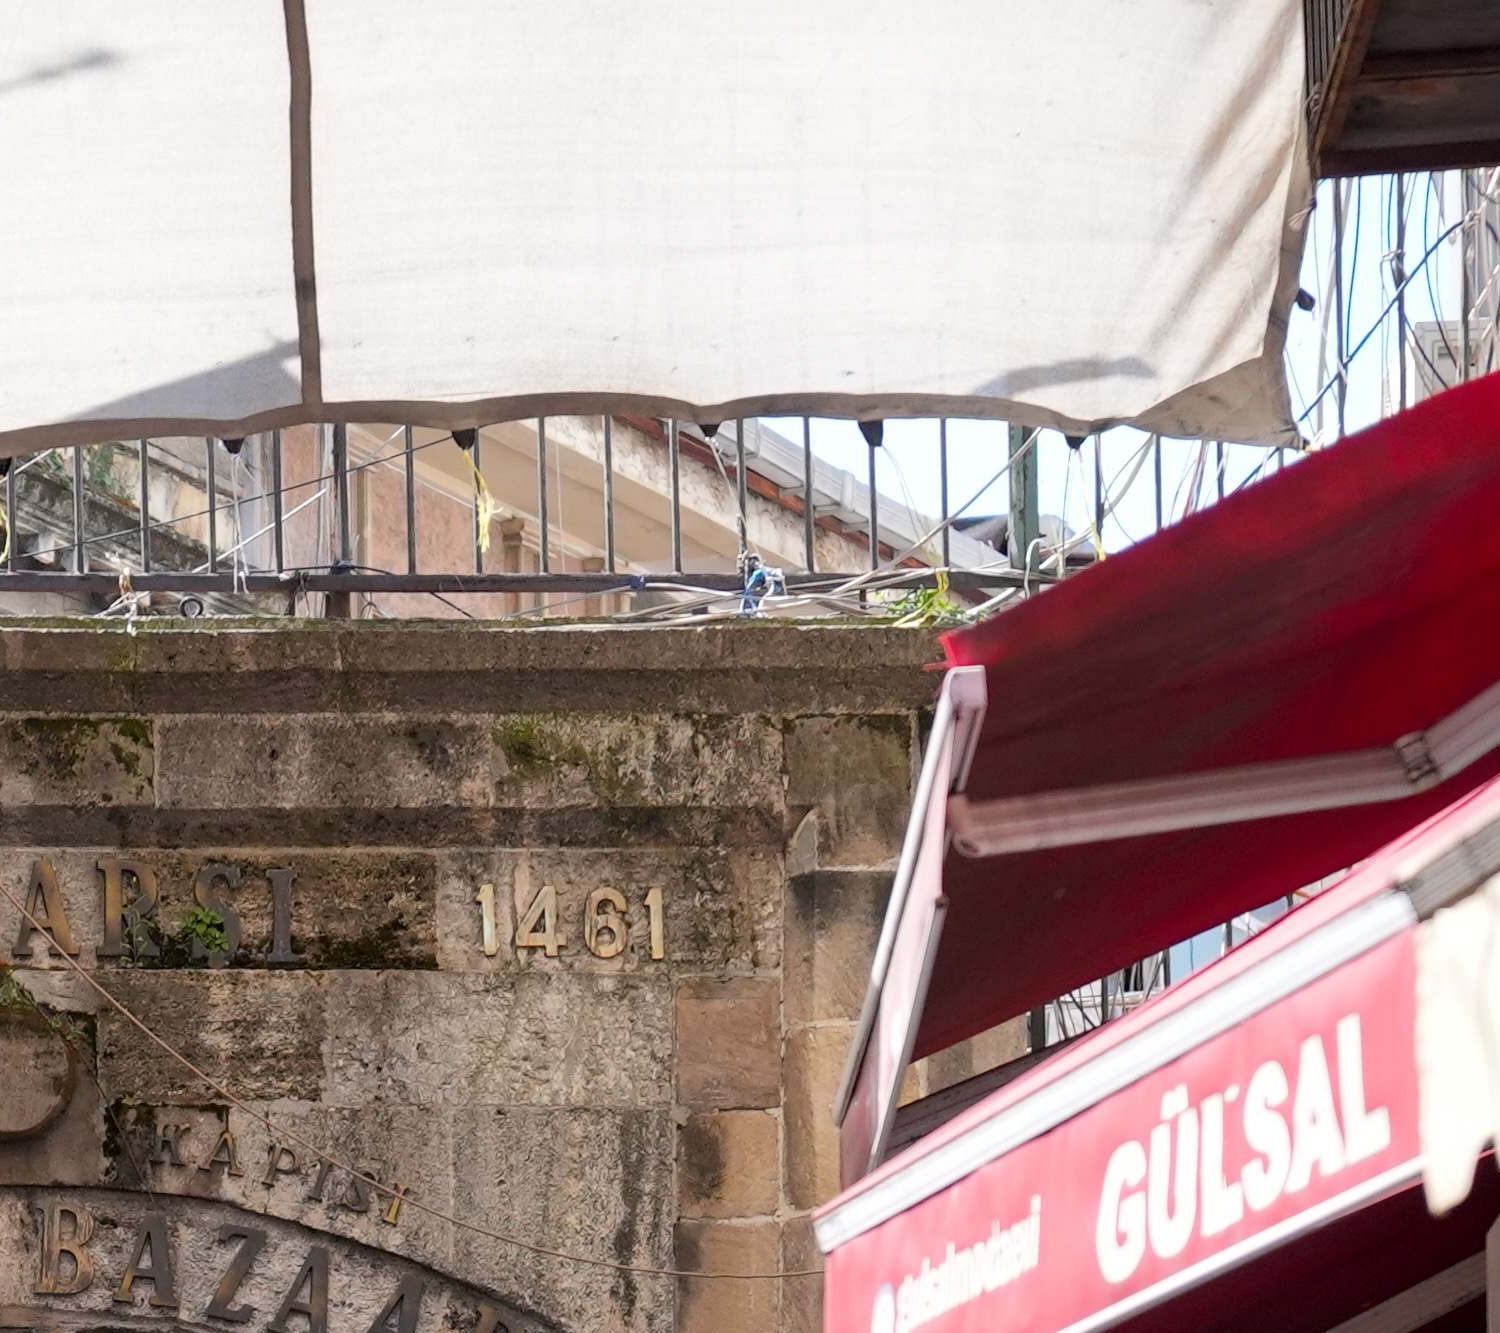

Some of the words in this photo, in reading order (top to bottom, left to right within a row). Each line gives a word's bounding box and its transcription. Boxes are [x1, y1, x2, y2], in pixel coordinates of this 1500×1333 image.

[475, 883, 666, 961] 1461
[148, 1122, 410, 1226] KAPISI
[1095, 1014, 1392, 1284] GÜLSAL
